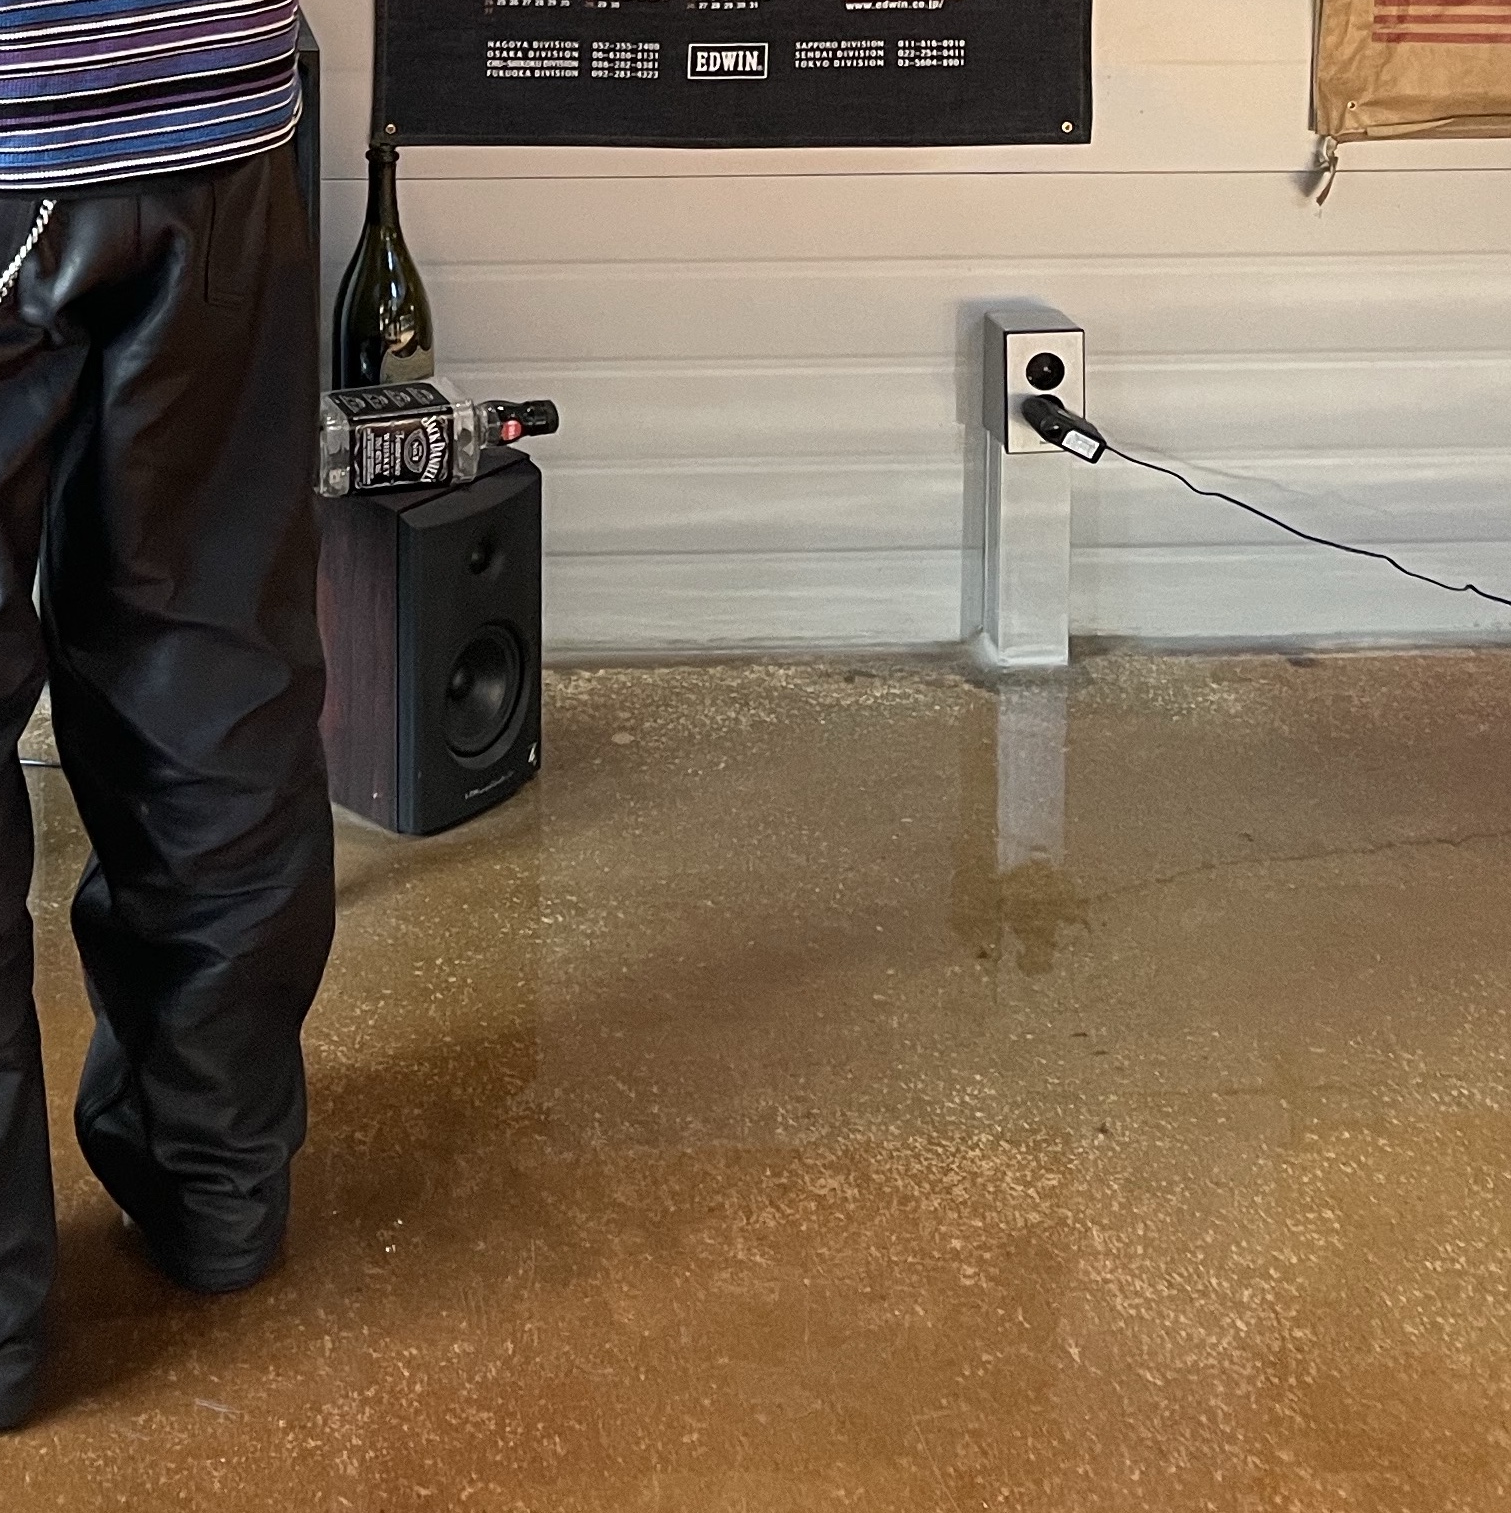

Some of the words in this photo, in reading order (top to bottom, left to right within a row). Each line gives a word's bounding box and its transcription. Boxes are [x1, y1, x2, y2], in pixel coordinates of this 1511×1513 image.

[846, 0, 944, 9] www.edwin.co.jp/
[488, 41, 528, 51] NAGOYA
[796, 48, 832, 58] SENDAI
[795, 57, 829, 67] TOKYO
